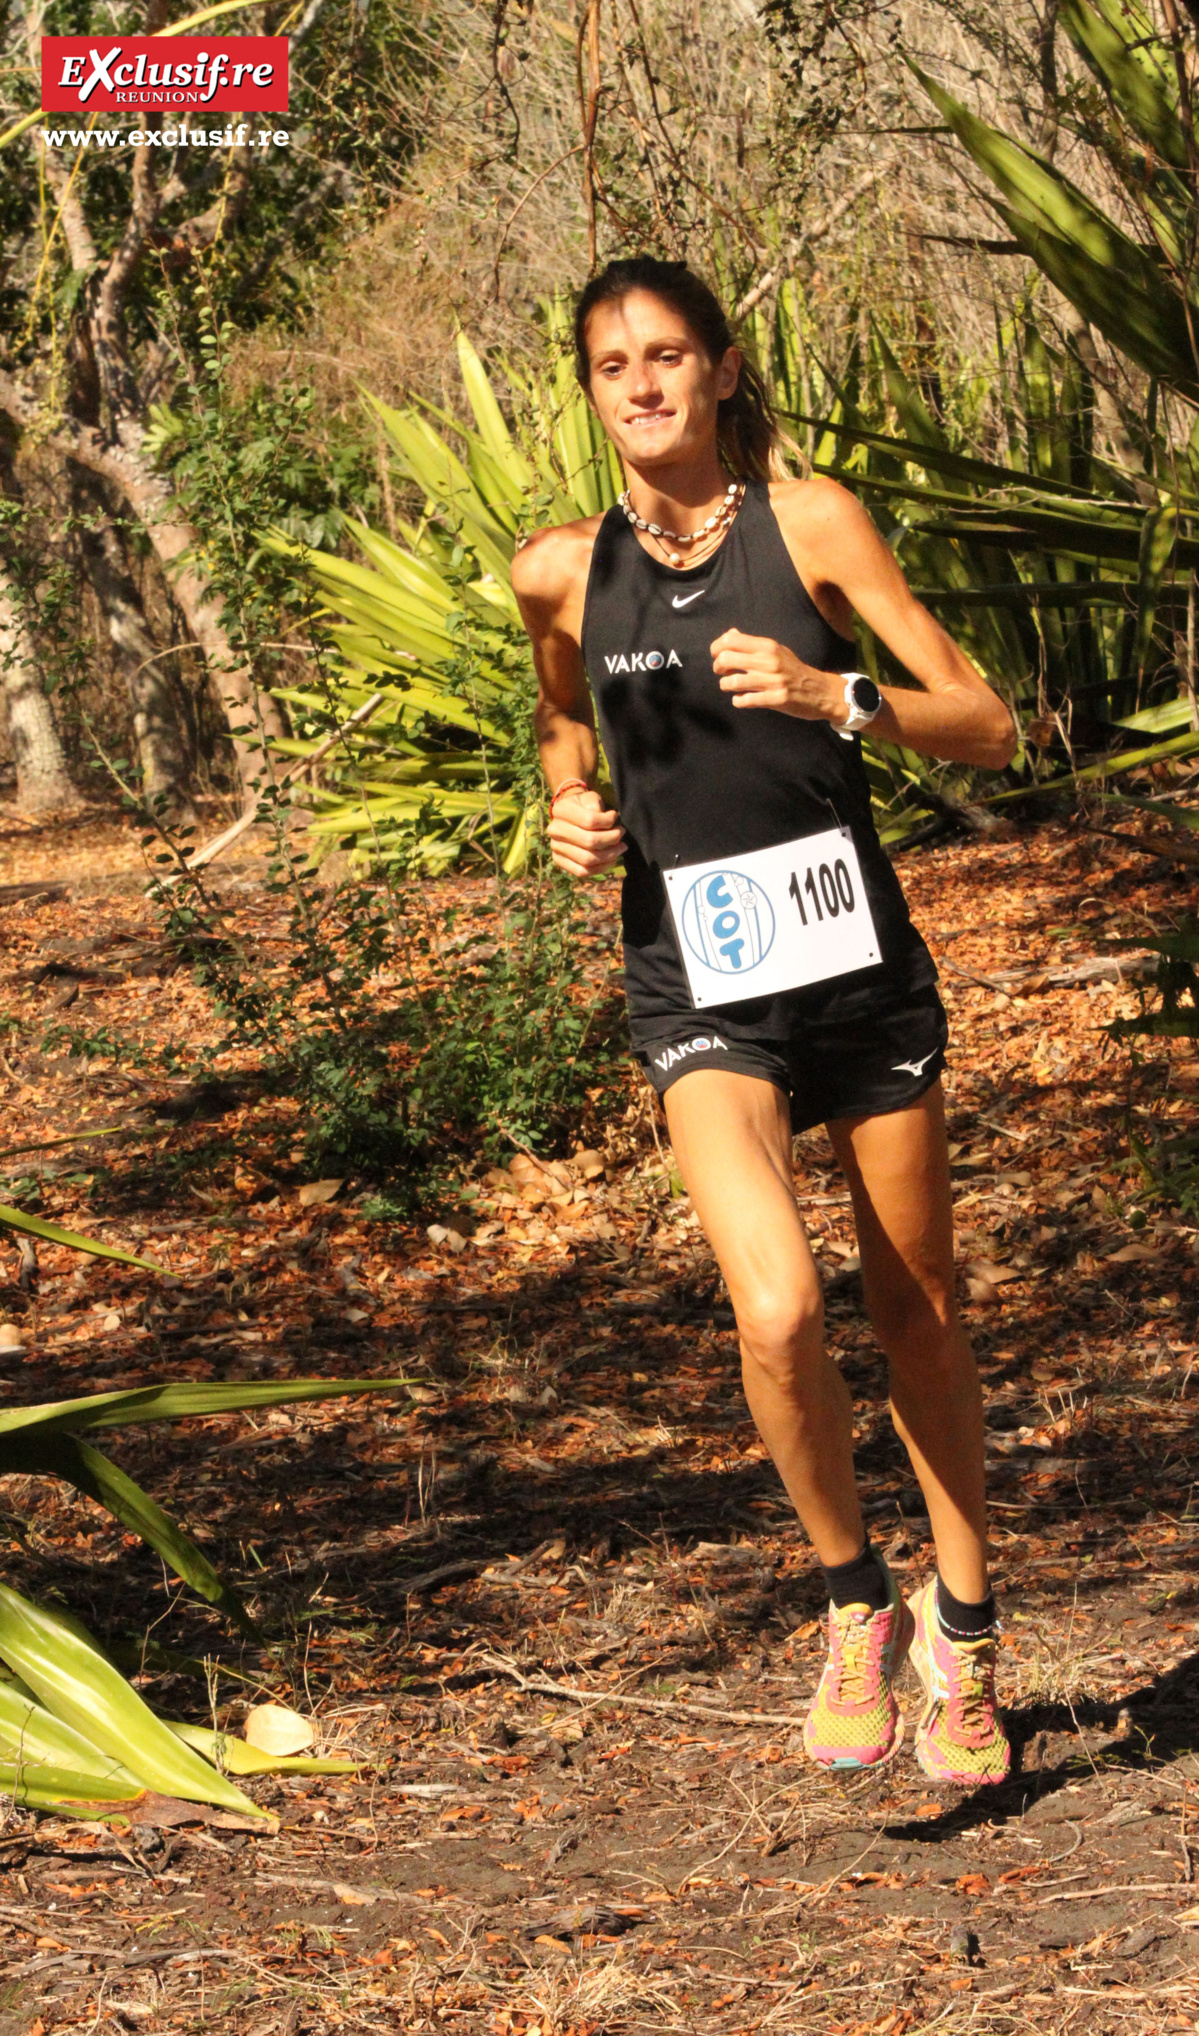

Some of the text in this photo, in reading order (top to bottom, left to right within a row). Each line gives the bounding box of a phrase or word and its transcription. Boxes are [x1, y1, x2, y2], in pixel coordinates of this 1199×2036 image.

[604, 649, 683, 674] VAKOA
[788, 858, 856, 926] 1100
[654, 1035, 728, 1072] VAKOA
